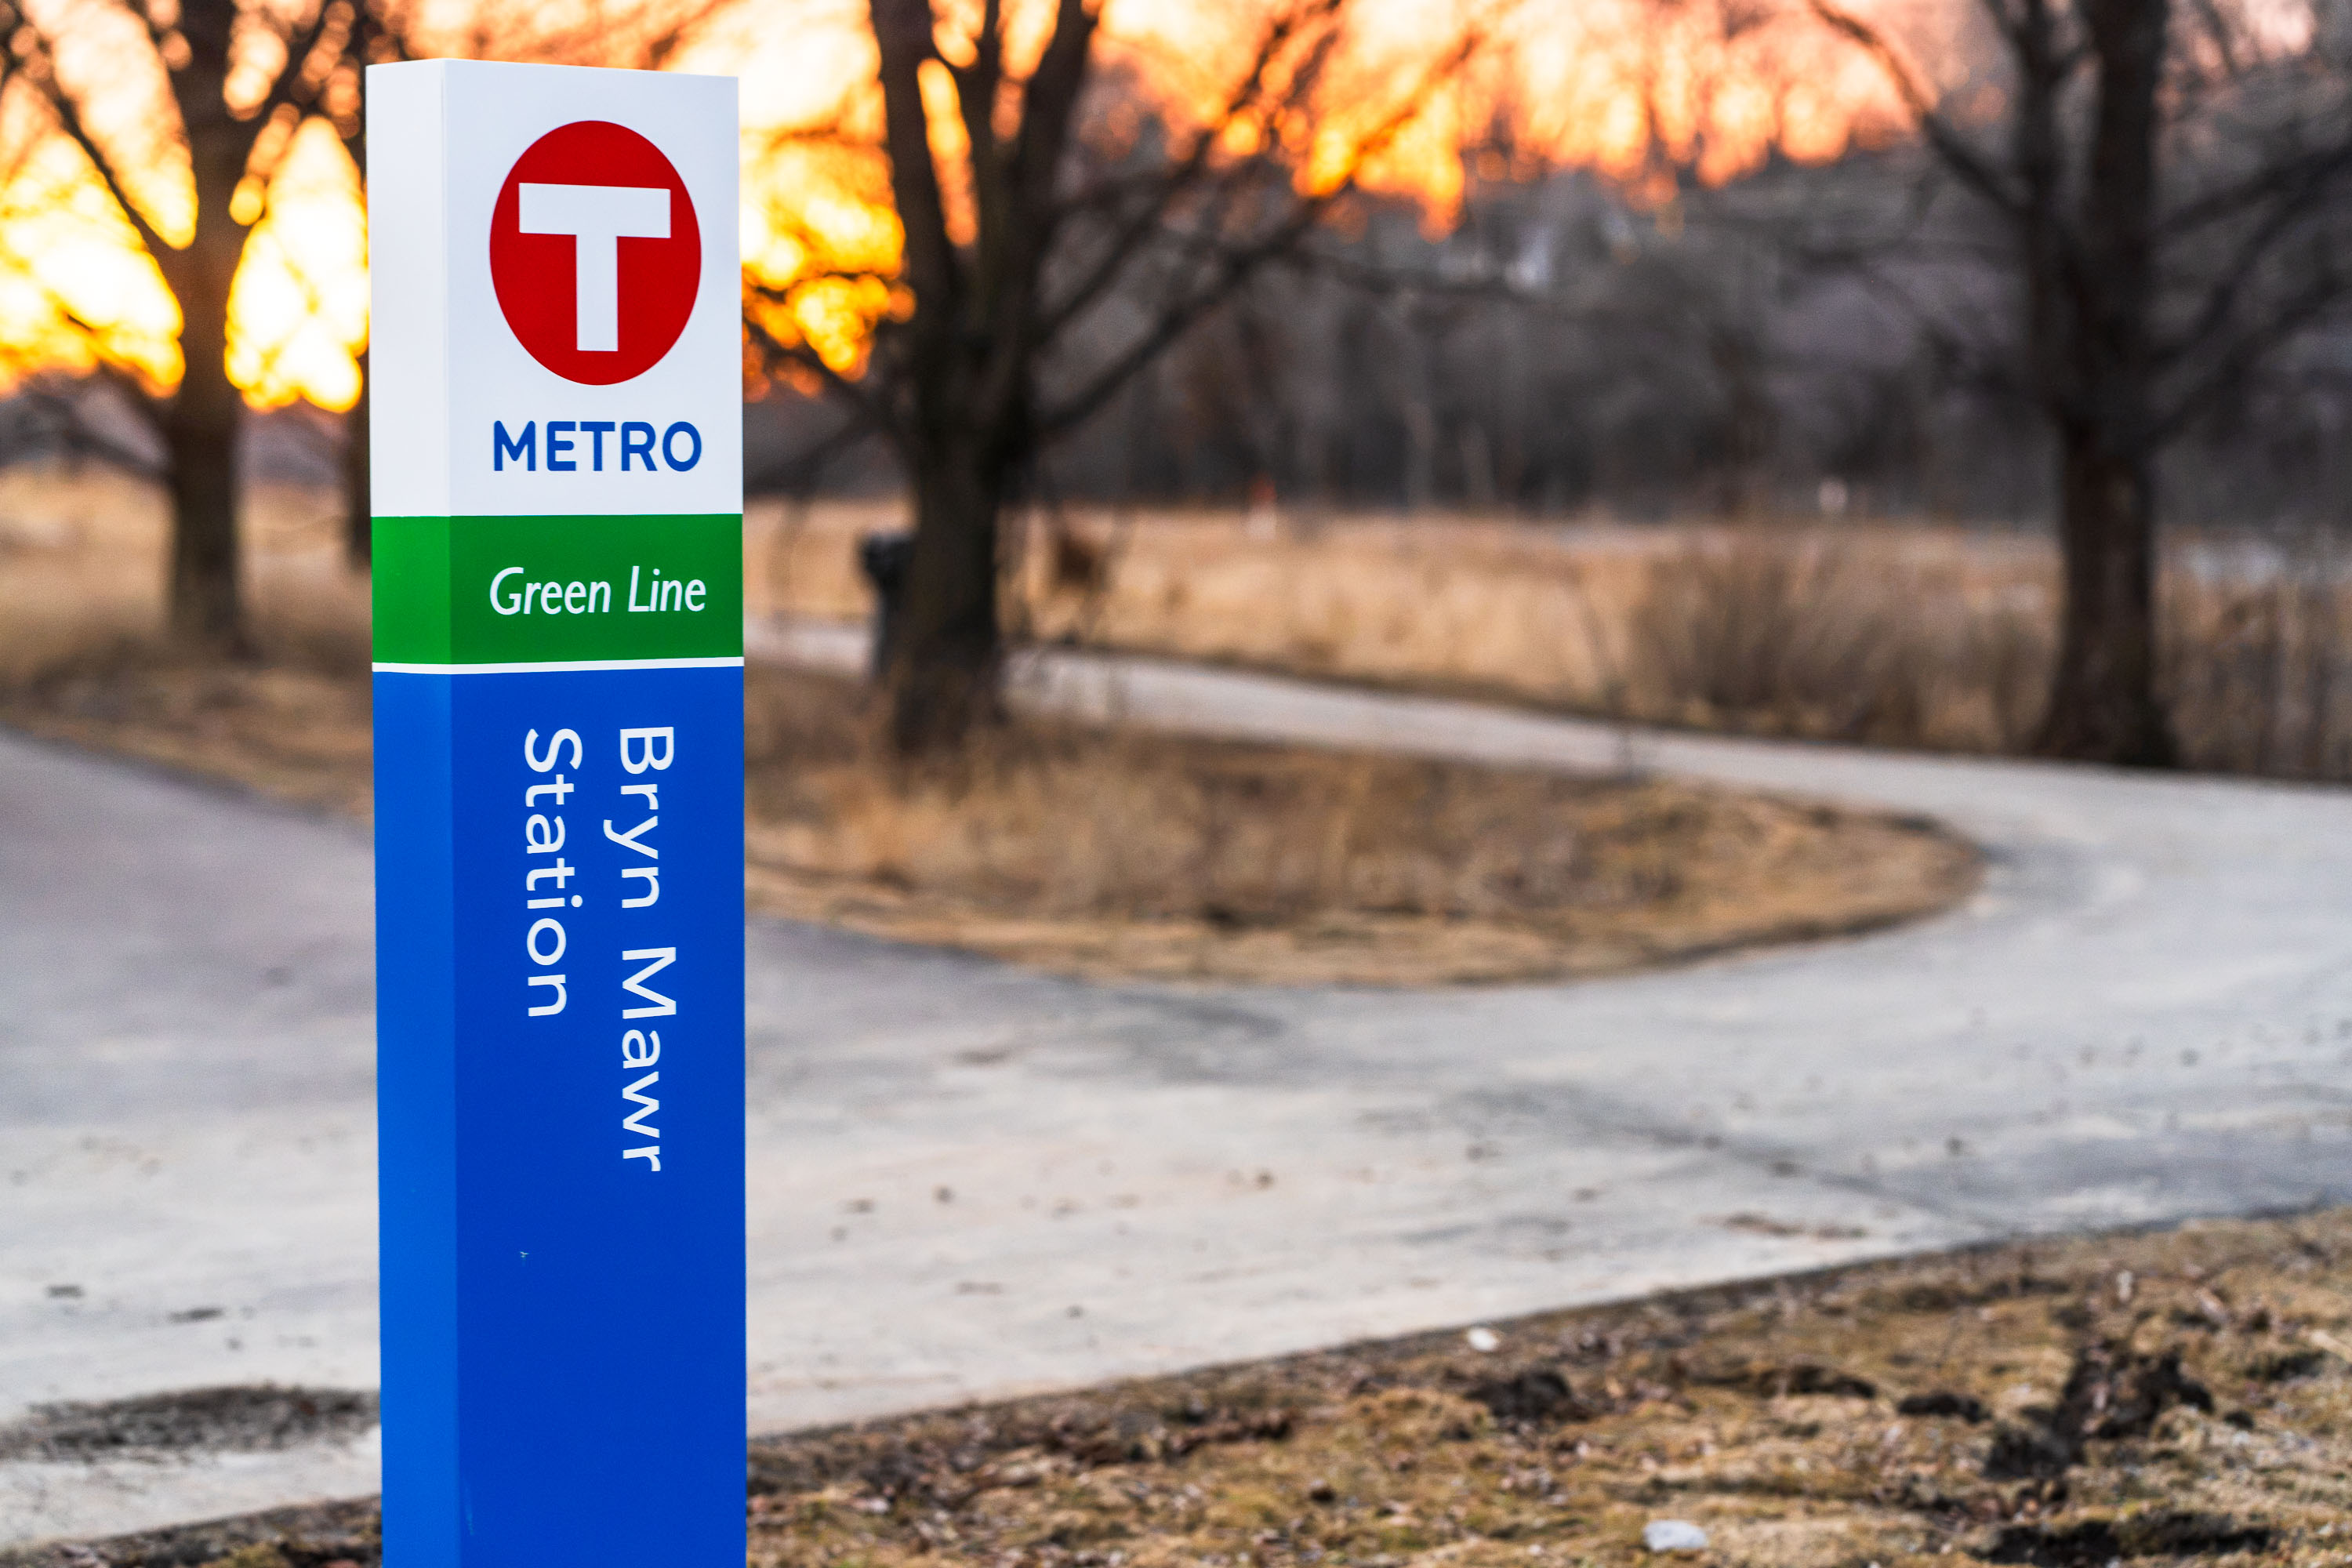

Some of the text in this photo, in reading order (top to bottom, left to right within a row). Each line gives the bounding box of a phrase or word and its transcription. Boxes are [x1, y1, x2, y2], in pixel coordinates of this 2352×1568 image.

[518, 182, 672, 353] T
[493, 419, 702, 473] METRO
[489, 565, 707, 616] Green Line
[523, 728, 584, 1018] Station
[602, 726, 677, 1173] Bryn Mawr
